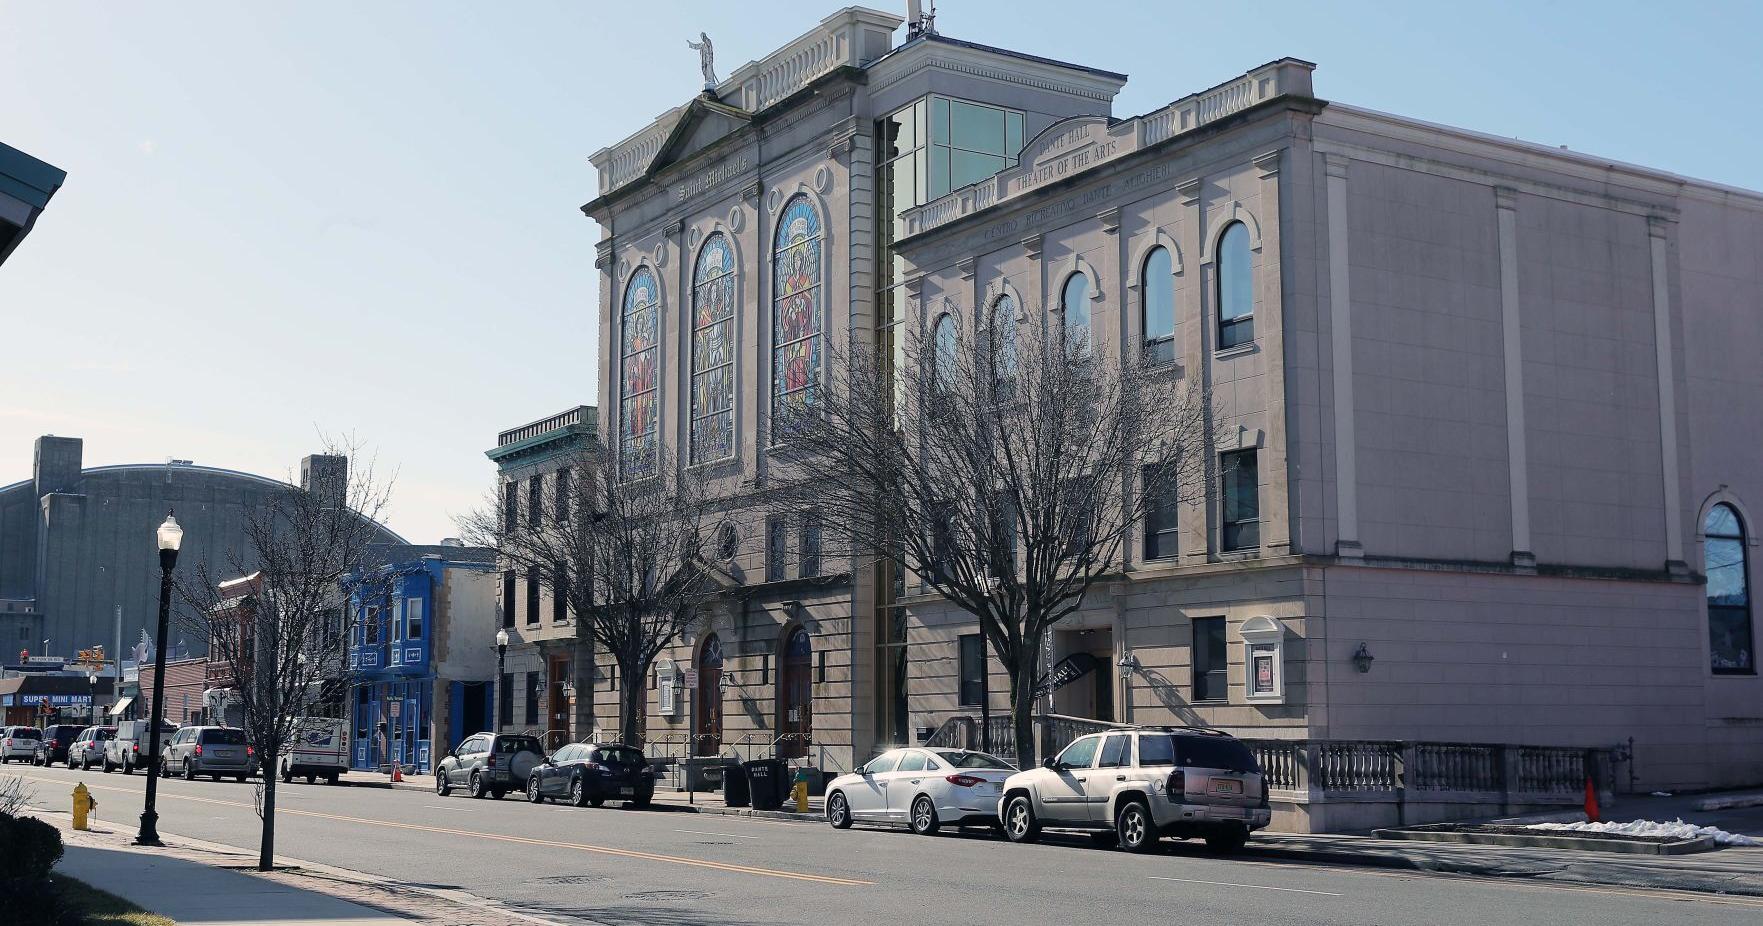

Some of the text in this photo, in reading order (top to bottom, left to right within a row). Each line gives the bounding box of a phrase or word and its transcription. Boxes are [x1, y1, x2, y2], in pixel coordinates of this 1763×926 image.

[1040, 125, 1090, 155] DANTE HALL
[679, 156, 748, 201] Saint Michael's
[1017, 140, 1117, 191] THEATER OF THE ARTS
[984, 219, 1018, 240] CENTRO
[1082, 184, 1112, 205] DANTE
[1124, 163, 1170, 189] ALIGHIERI
[52, 695, 68, 703] MINI
[71, 695, 92, 703] MART
